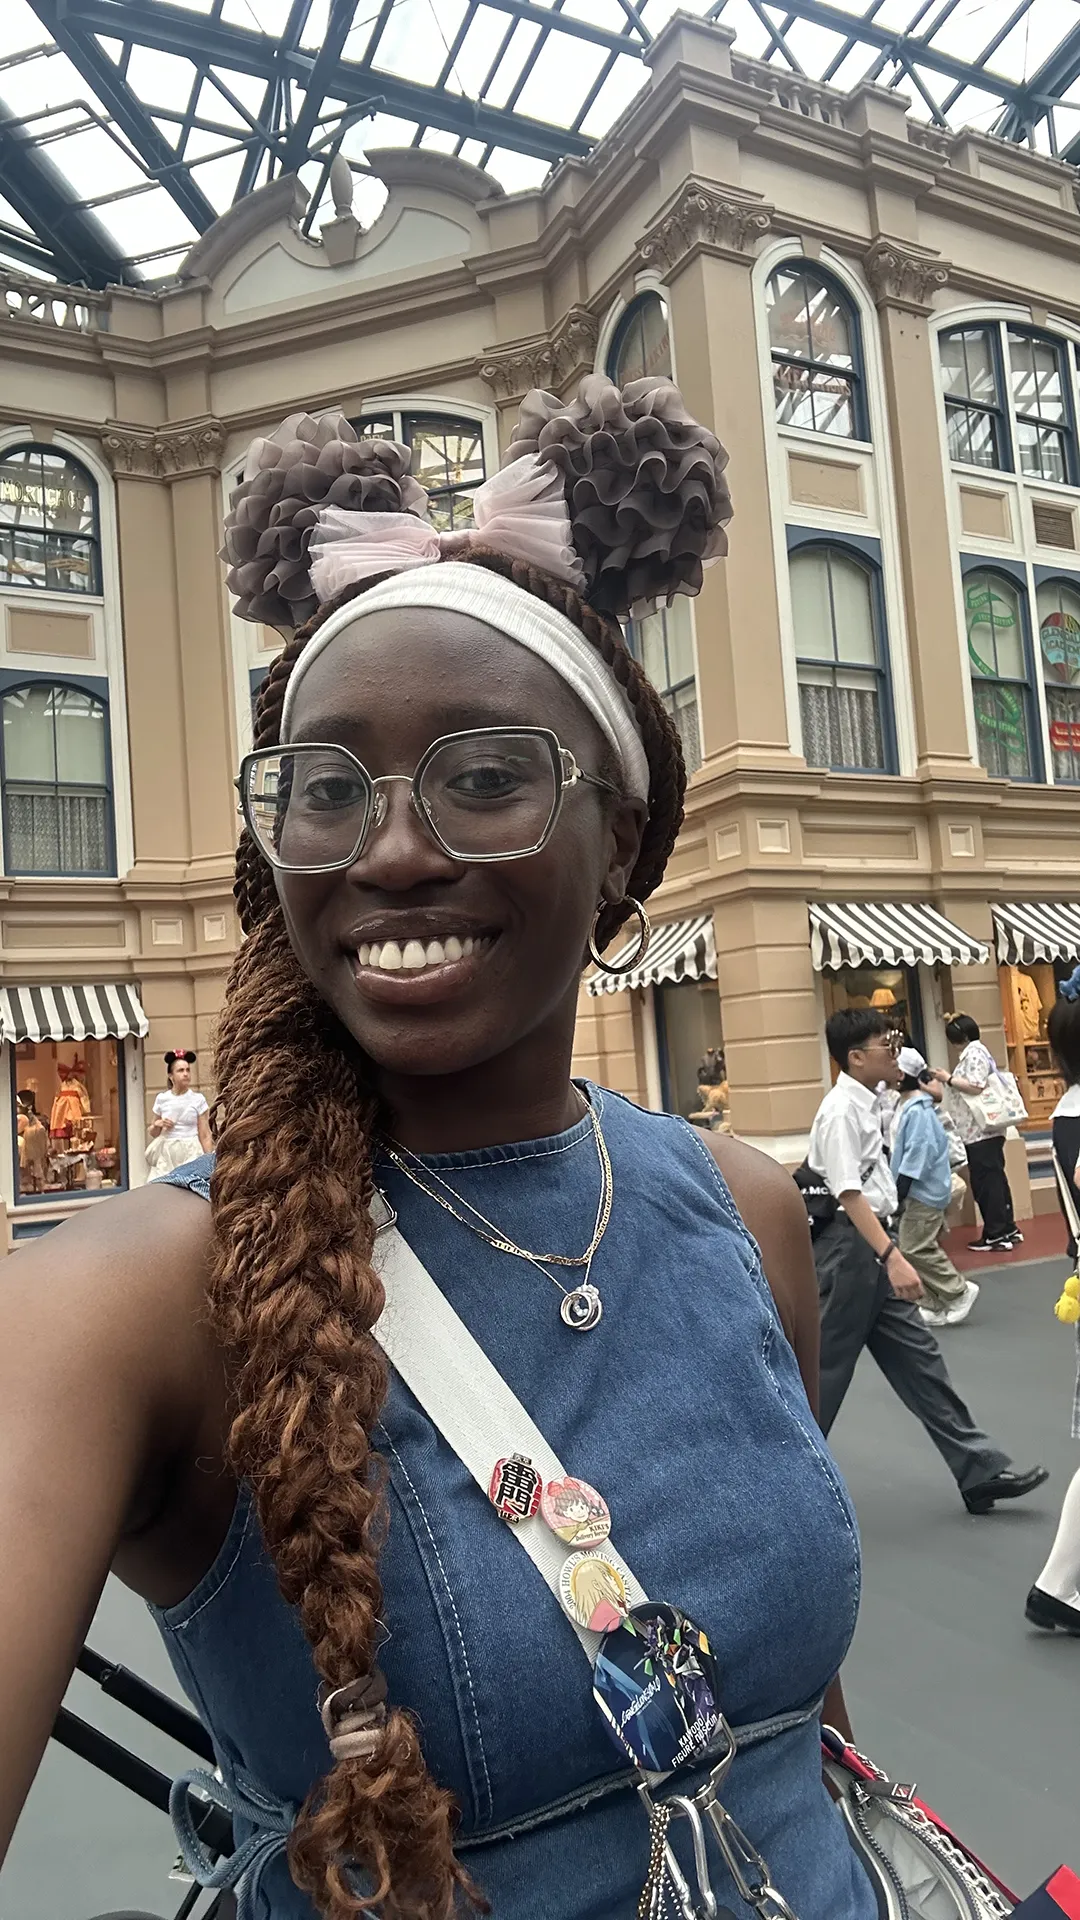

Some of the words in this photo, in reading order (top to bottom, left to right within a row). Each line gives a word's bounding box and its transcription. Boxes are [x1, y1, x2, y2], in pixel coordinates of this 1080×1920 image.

[496, 1461, 537, 1516] 雷門
[589, 1523, 609, 1532] KIKI'S
[562, 1554, 580, 1587] HOWL'S
[581, 1551, 615, 1566] MOVING
[671, 1741, 696, 1768] FIGURE
